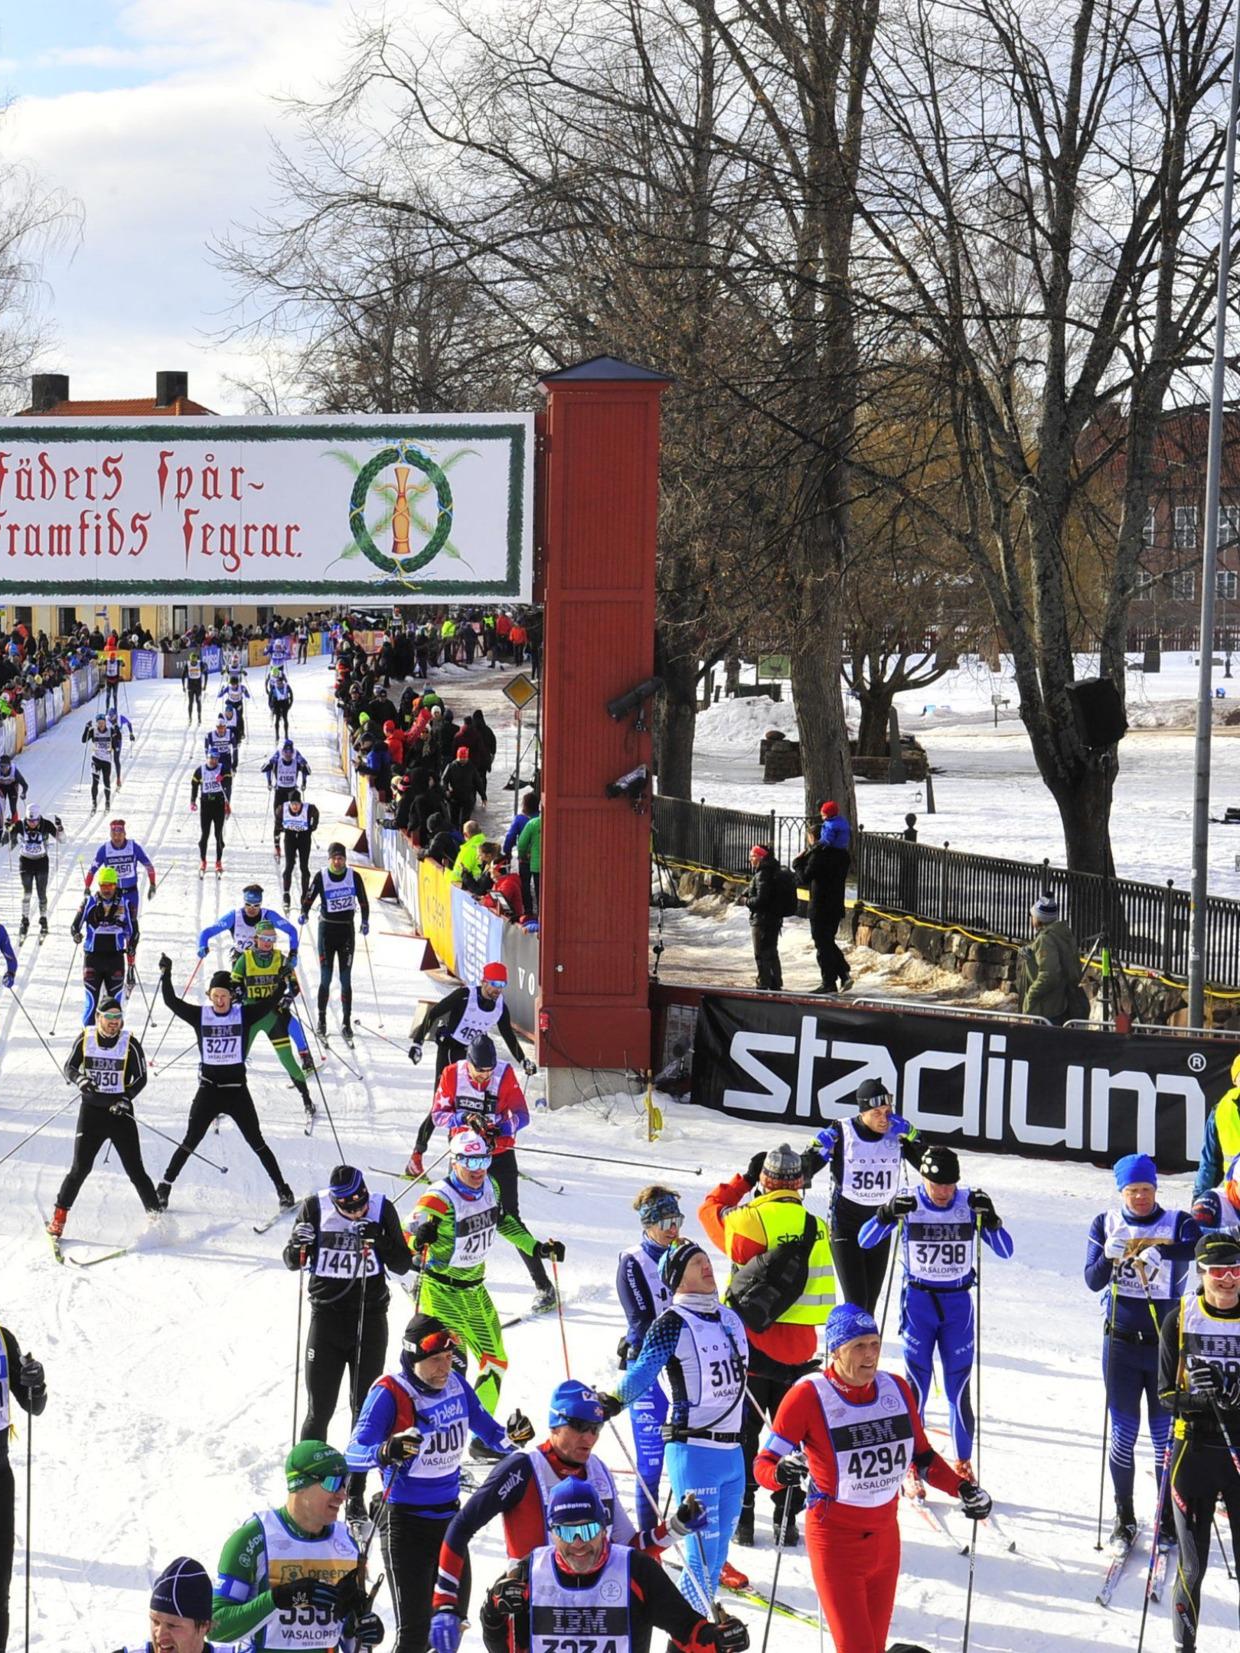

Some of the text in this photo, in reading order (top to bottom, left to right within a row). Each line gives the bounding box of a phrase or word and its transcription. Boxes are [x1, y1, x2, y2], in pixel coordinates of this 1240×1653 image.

[329, 897, 353, 911] 3522
[210, 1025, 234, 1037] IBM
[205, 1038, 238, 1054] 3277
[91, 1058, 118, 1071] IBM
[89, 1070, 119, 1086] 5030
[722, 1015, 1207, 1163] stadium
[851, 1170, 892, 1190] 3641
[464, 1210, 493, 1233] IBM
[922, 1224, 962, 1240] IBM
[915, 1243, 967, 1265] 3798
[847, 1418, 897, 1447] IBM
[847, 1443, 907, 1480] 4294
[308, 1565, 349, 1580] preem
[552, 1609, 608, 1634] IBM
